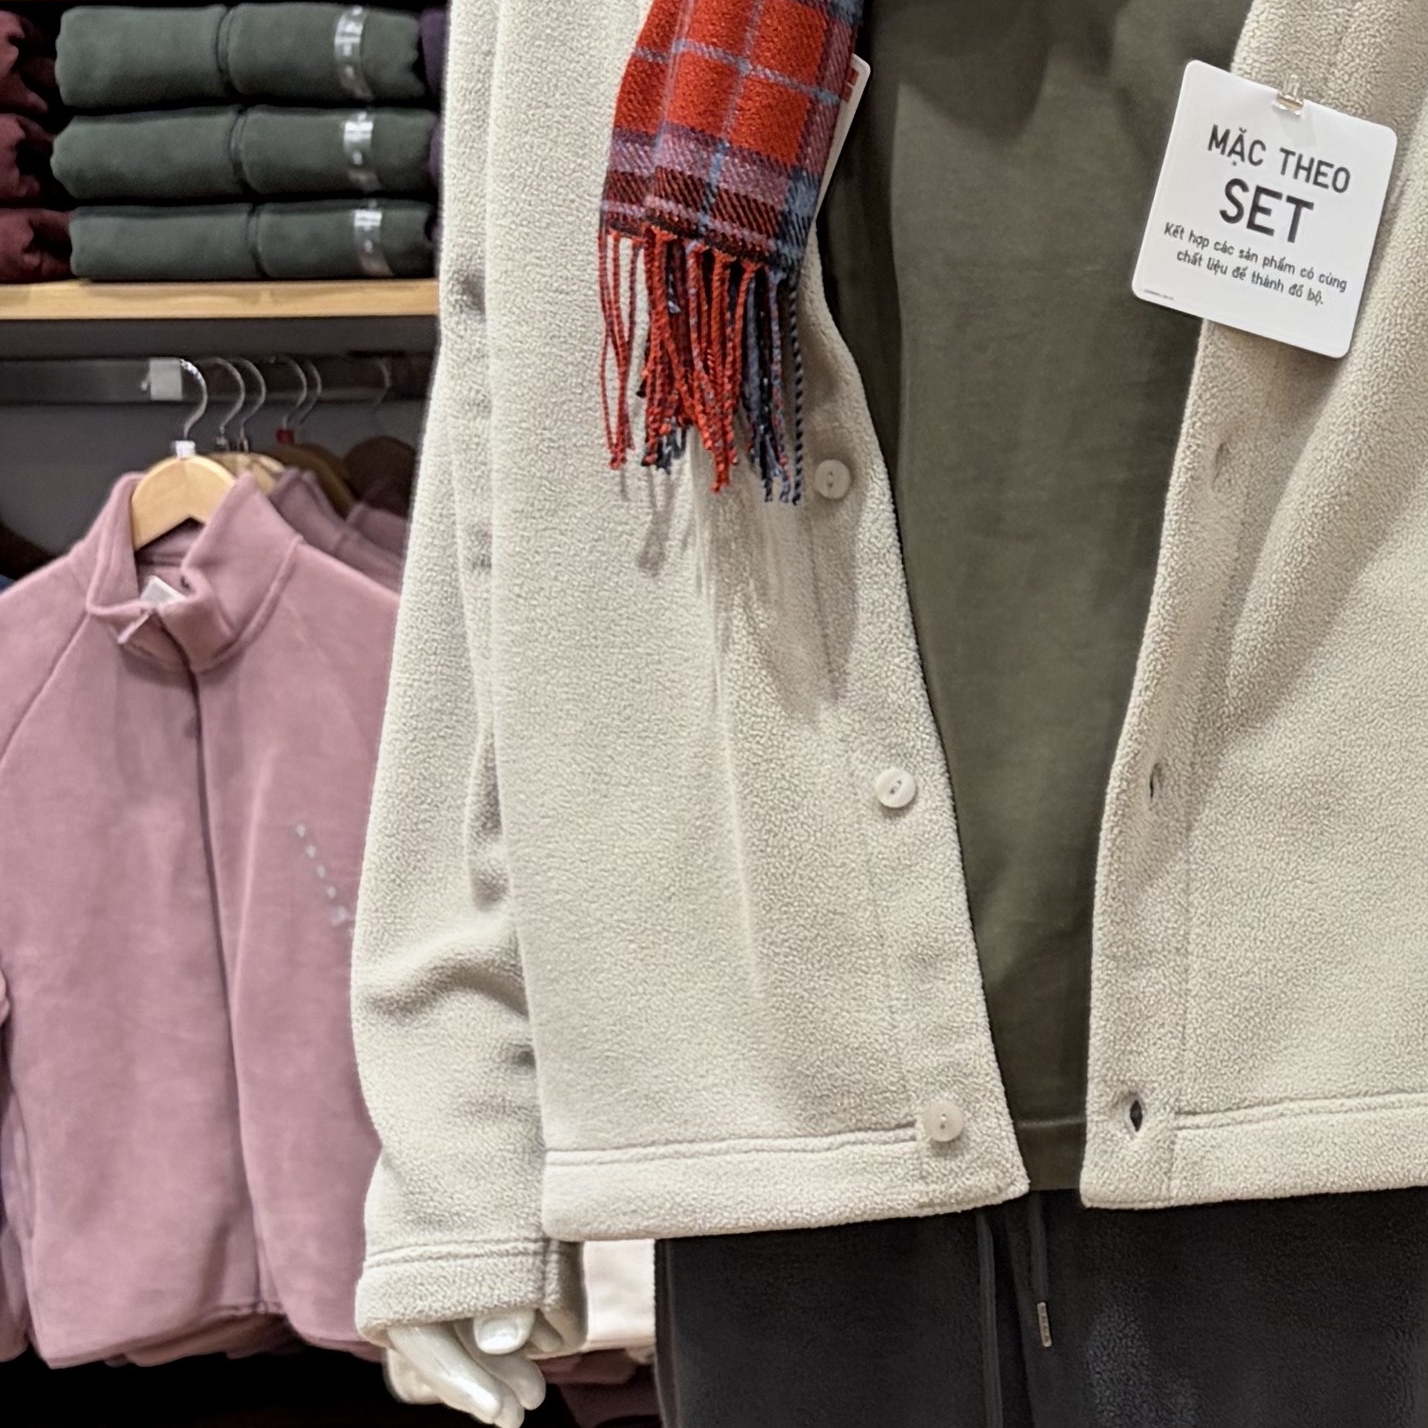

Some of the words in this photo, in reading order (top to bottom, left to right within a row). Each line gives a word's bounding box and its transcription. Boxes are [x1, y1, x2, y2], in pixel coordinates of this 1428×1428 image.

[1206, 124, 1267, 166] MẶC
[1279, 147, 1351, 194] THEO
[1218, 177, 1315, 245] SET
[1163, 222, 1185, 241] Kết
[1188, 229, 1210, 250] hợp
[1213, 239, 1235, 257] các
[1238, 246, 1259, 265] sản
[1262, 254, 1296, 276] phẩm
[1299, 265, 1315, 281] có
[1318, 271, 1348, 293] cùng
[1176, 248, 1204, 268] chất
[1206, 257, 1228, 278] liệu
[1251, 270, 1285, 293] thành
